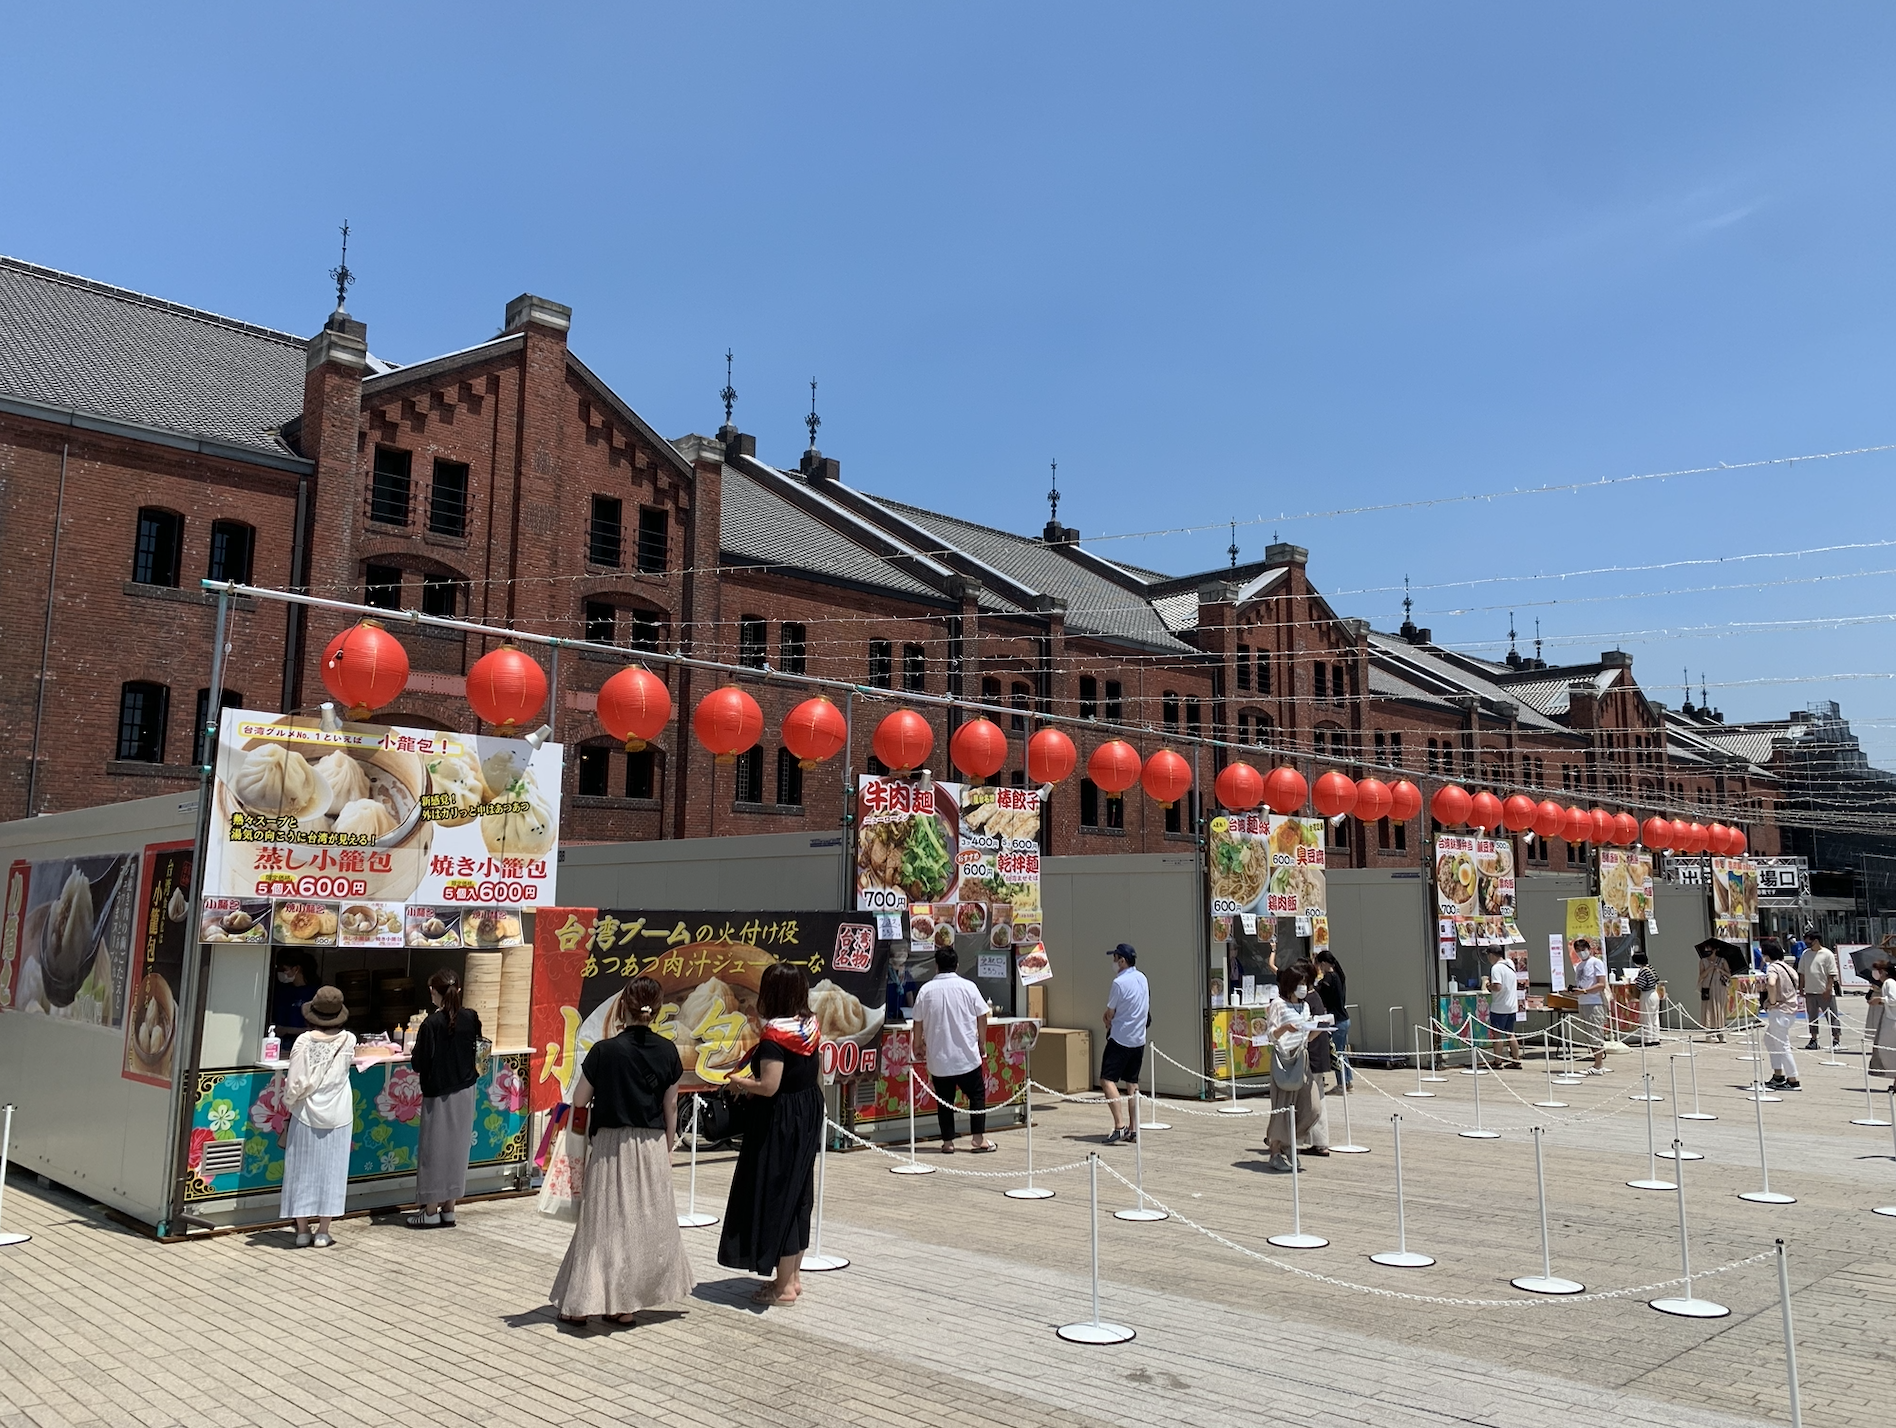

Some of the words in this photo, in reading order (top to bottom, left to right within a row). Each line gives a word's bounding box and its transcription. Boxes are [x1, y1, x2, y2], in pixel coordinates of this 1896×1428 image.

[231, 812, 298, 829] 熱々スープと
[253, 846, 393, 873] 蒸し小籠包
[429, 854, 548, 879] 焼き小籠包
[963, 863, 993, 877] 600円
[1757, 870, 1795, 887] 場口
[863, 891, 906, 909] 700円
[554, 913, 800, 952] 台湾ブームの火付け役
[839, 927, 871, 950] 台湾
[835, 949, 871, 969] 名物
[818, 1040, 877, 1077] 00円
